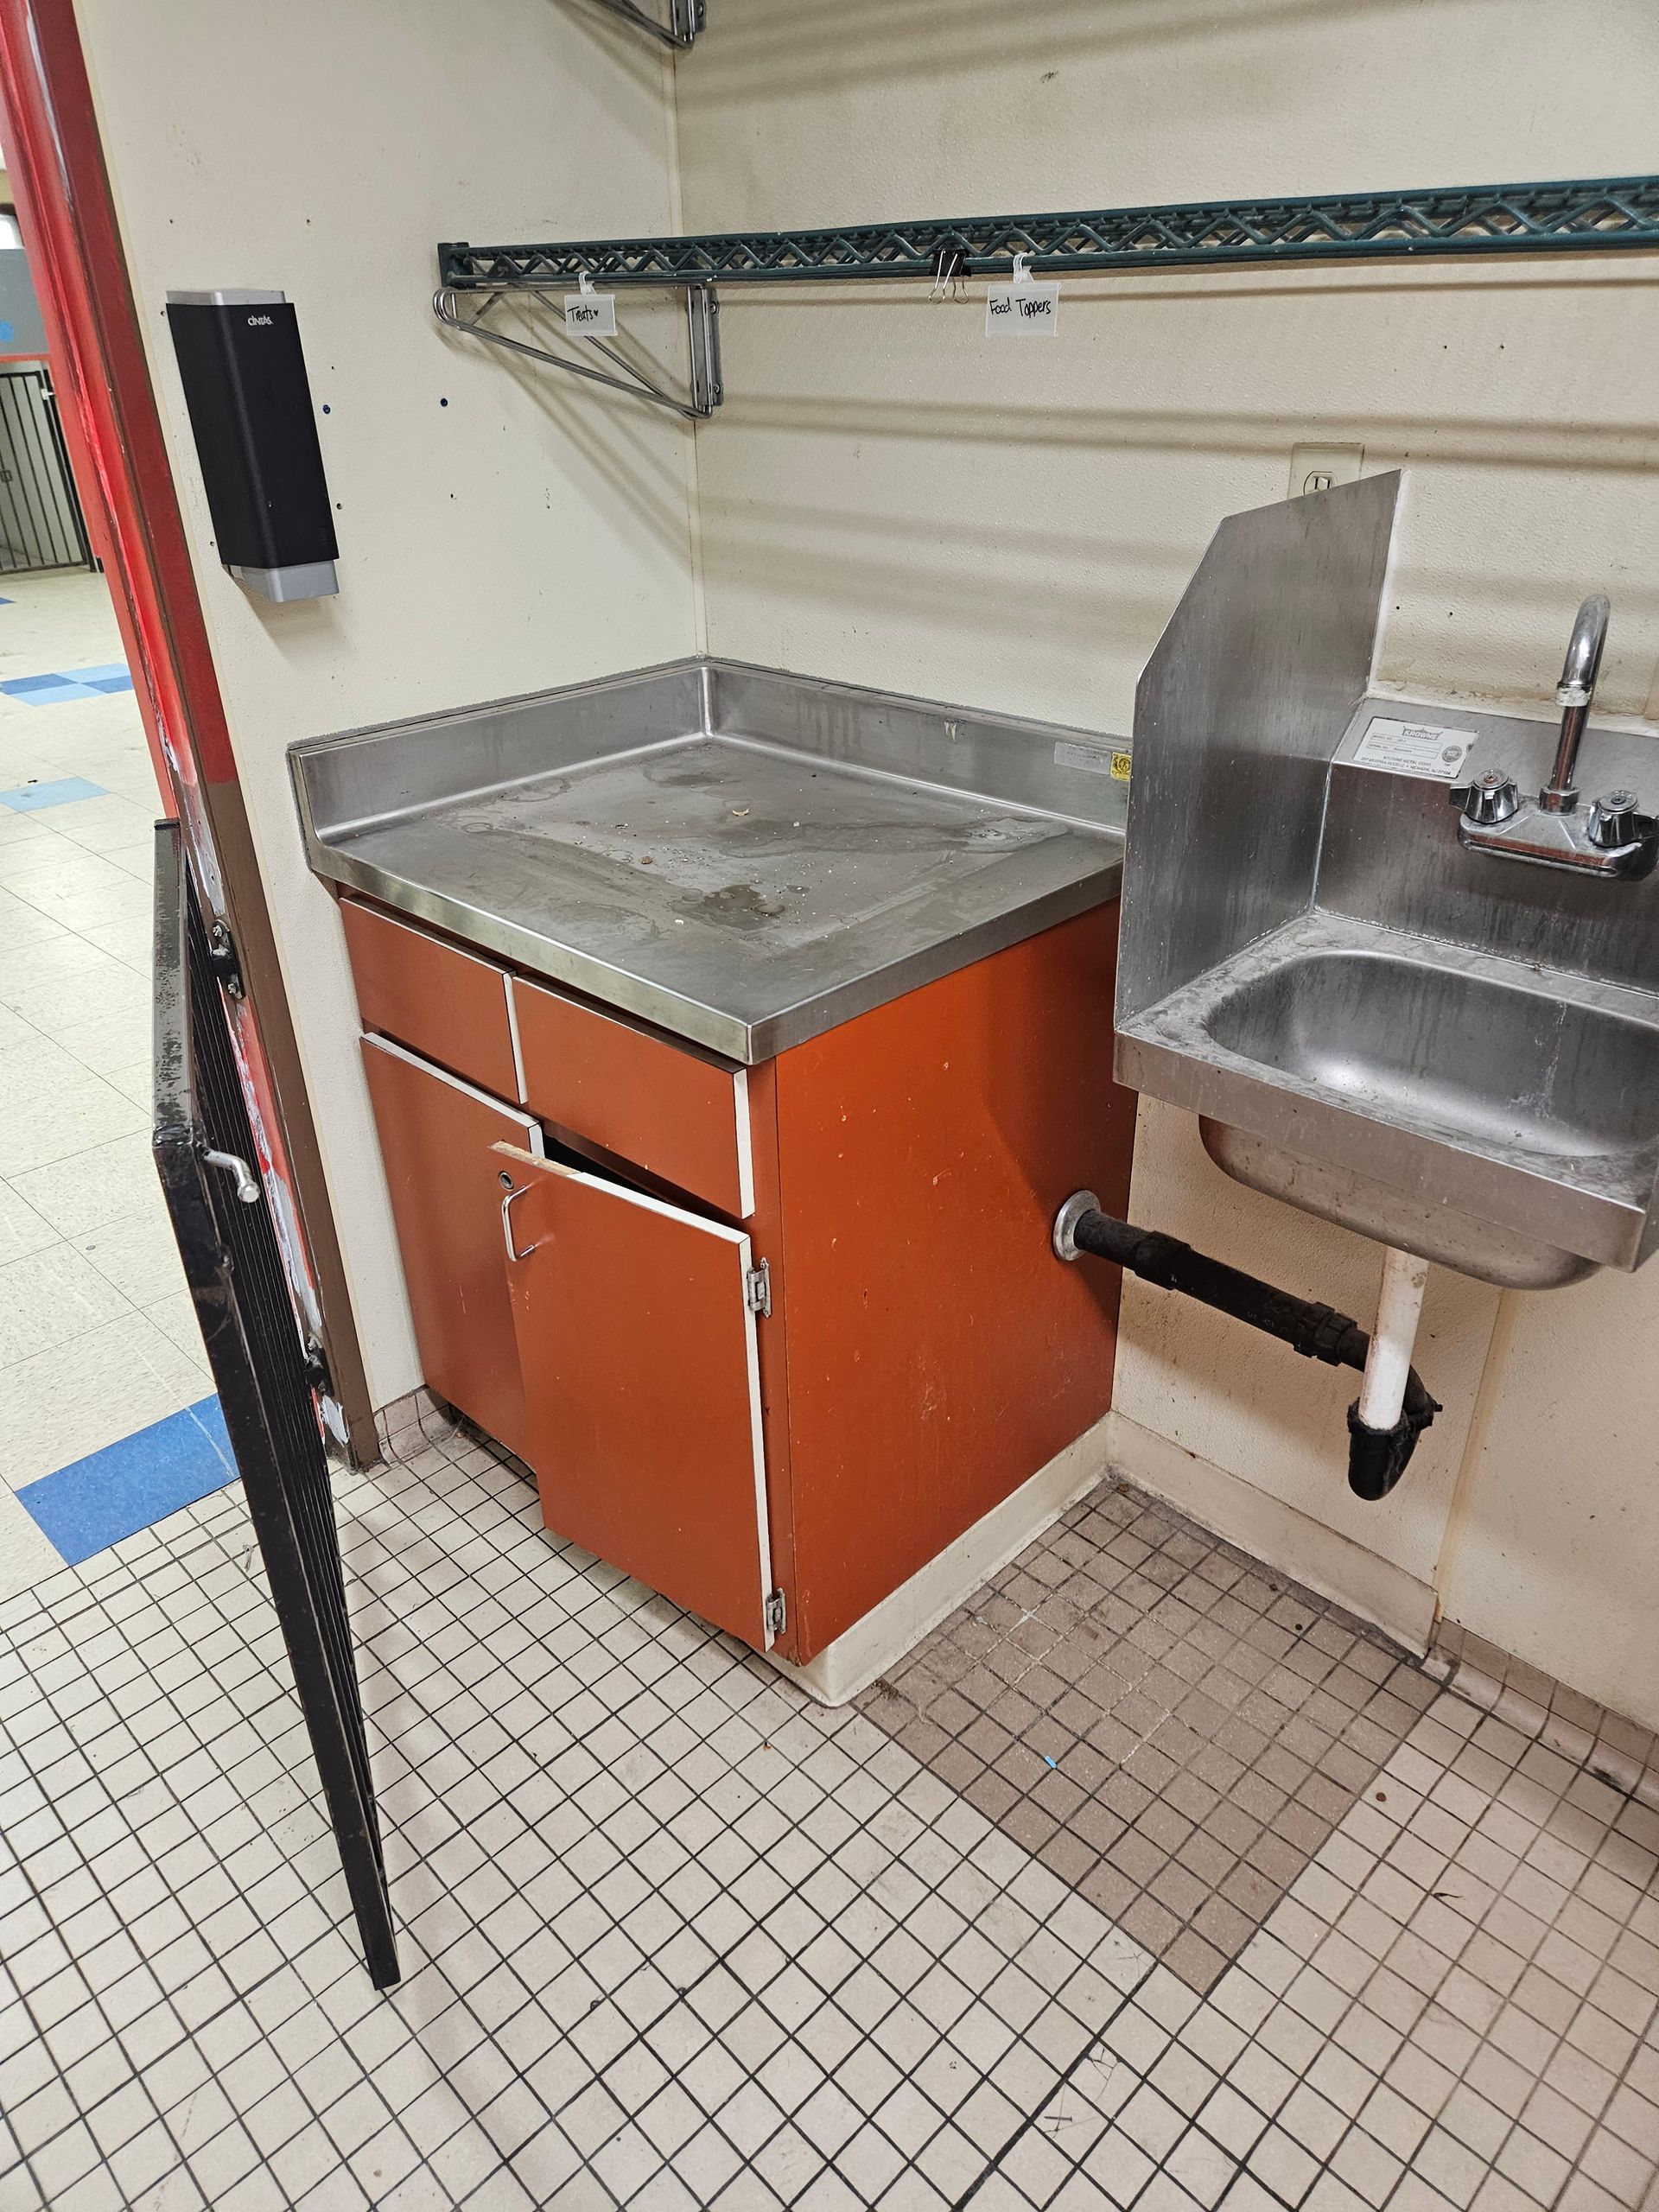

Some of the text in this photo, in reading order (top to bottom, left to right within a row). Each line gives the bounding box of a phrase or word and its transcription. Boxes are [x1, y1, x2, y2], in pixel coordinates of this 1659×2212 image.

[567, 304, 594, 322] Treats
[989, 296, 1052, 319] Food Toppers
[1403, 730, 1438, 740] KROWNE
